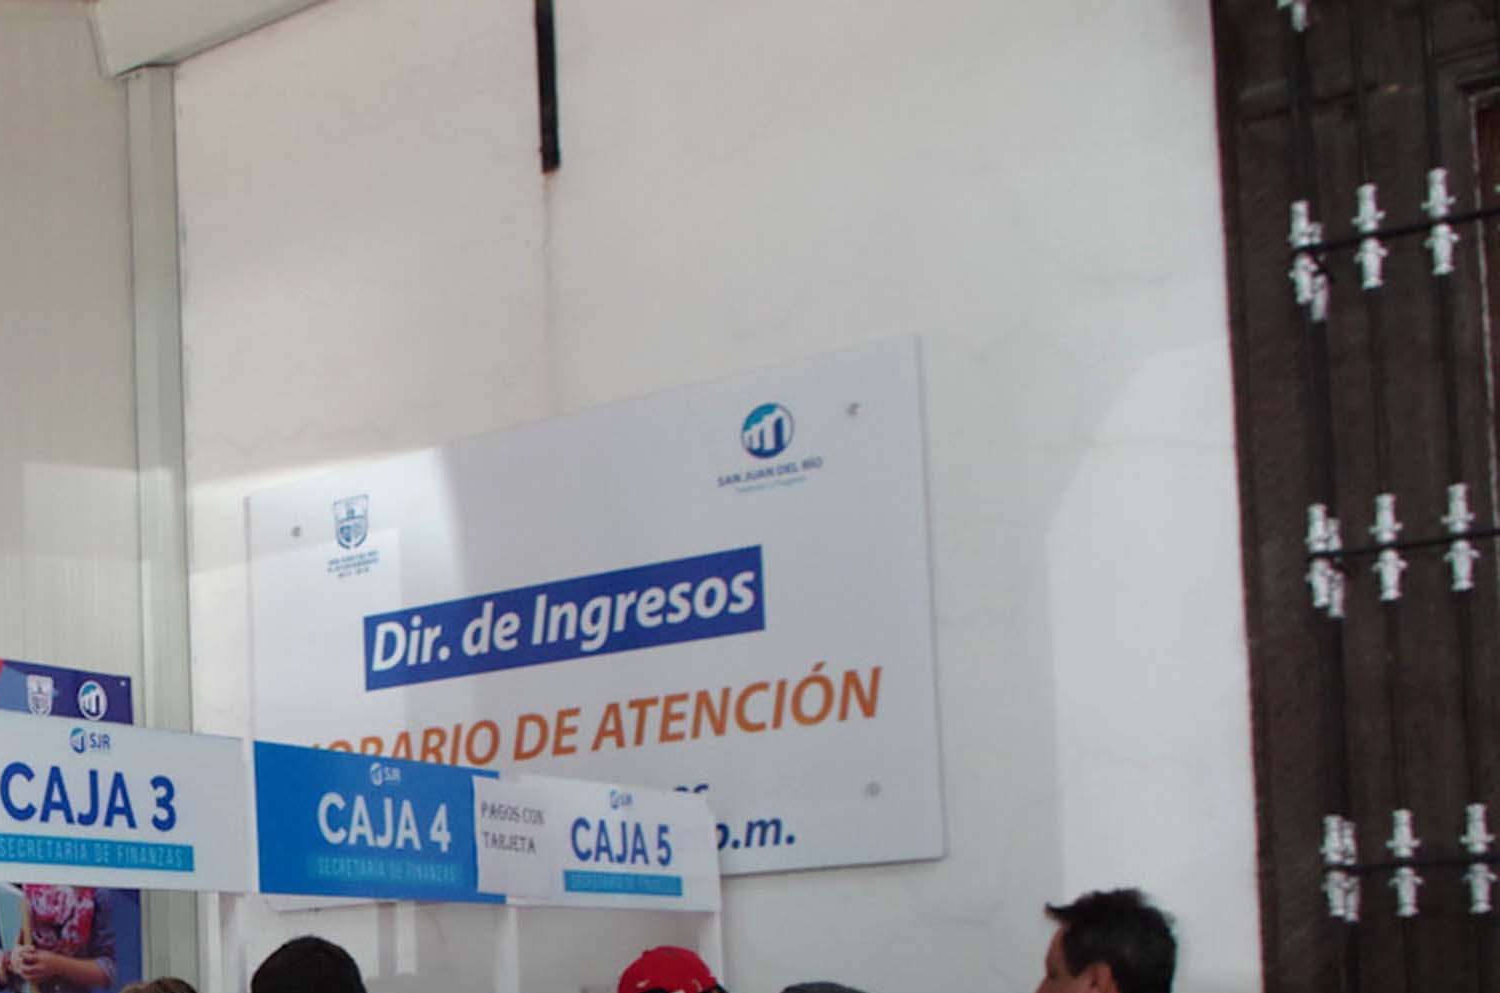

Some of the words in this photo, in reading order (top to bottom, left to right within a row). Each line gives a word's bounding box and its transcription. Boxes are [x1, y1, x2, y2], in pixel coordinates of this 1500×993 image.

[371, 615, 451, 672] Dir.
[461, 601, 521, 657] de
[531, 569, 757, 652] Ingresos
[513, 706, 582, 761] DE
[591, 660, 882, 752] ATENCIÓN
[89, 733, 111, 750] SJR
[0, 761, 138, 829] CAJA
[150, 775, 178, 832] 3
[480, 800, 521, 823] PAGOS
[318, 792, 422, 850] CAJA
[430, 803, 452, 853] 4
[482, 830, 538, 857] TARJETA
[571, 816, 650, 864] CAJA
[656, 823, 672, 867] 5
[94, 843, 110, 864] DE
[116, 845, 183, 867] FINANZAS
